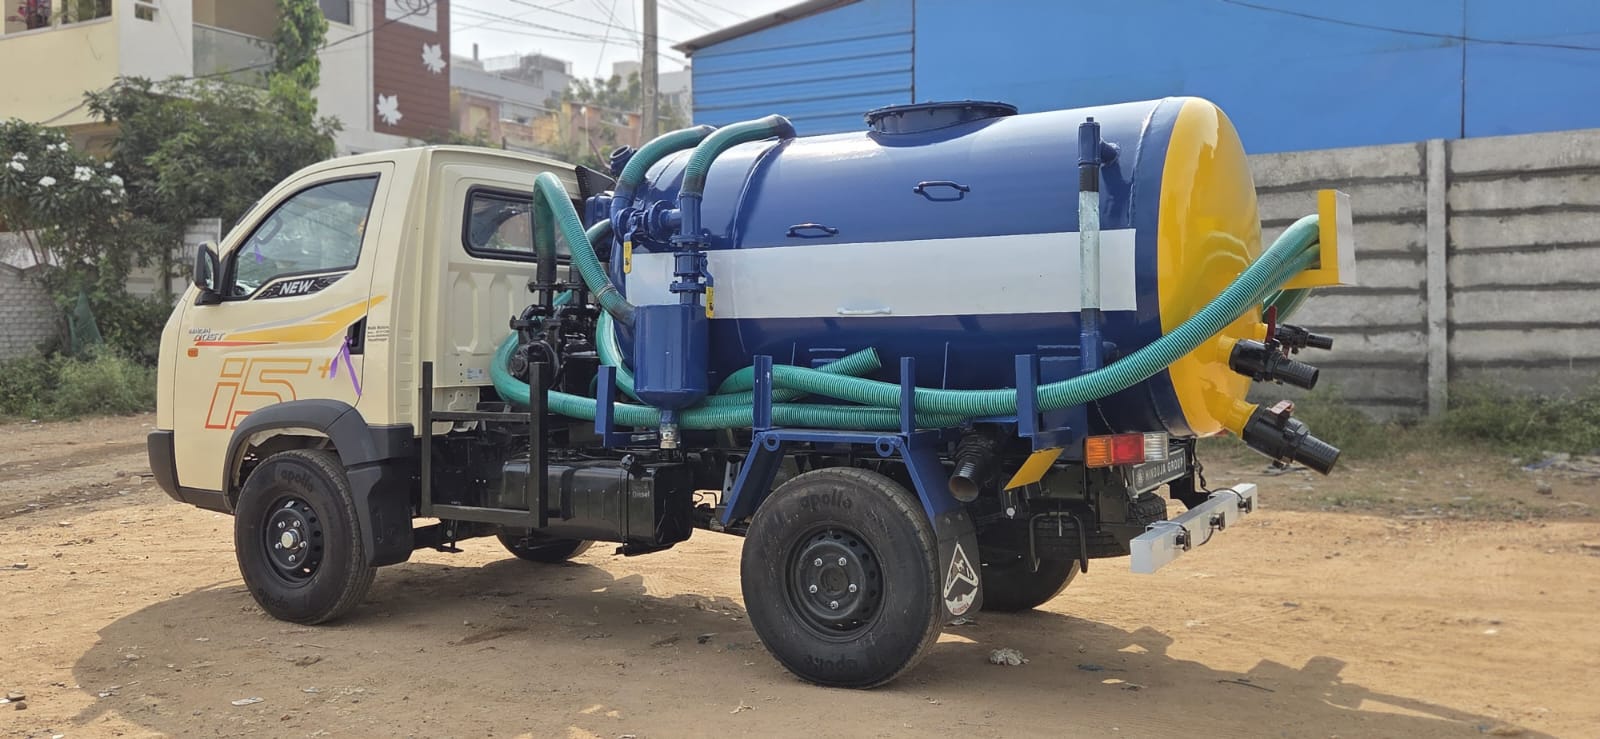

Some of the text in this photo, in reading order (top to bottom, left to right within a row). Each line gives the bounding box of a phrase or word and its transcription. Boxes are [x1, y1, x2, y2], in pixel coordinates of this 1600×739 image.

[279, 280, 315, 295] NEW
[1145, 457, 1184, 480] HINDUJA GROUP
[281, 470, 313, 492] apollo
[800, 489, 852, 511] apollo
